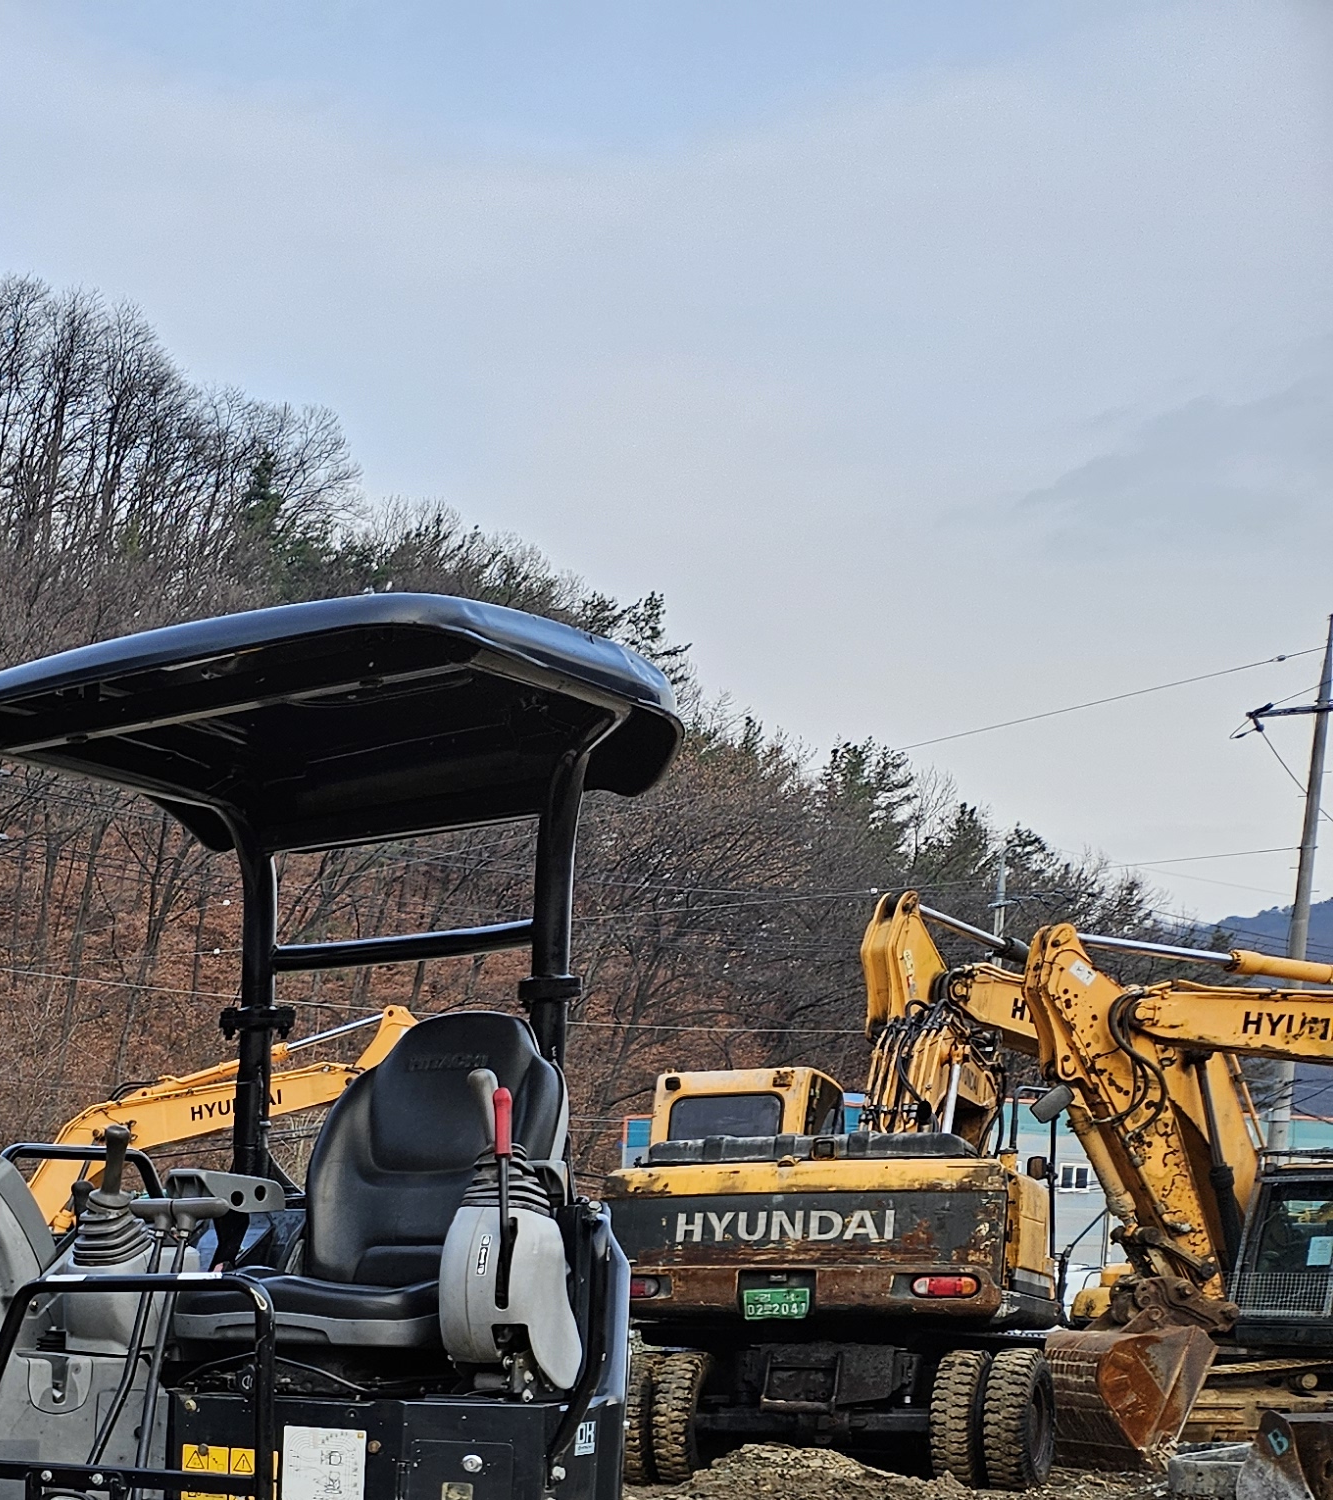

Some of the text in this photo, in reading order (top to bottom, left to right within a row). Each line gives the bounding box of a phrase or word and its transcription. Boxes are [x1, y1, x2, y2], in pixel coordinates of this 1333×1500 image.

[1011, 997, 1035, 1023] H
[675, 1209, 896, 1243] HYUNDAI
[1268, 1428, 1288, 1455] B
